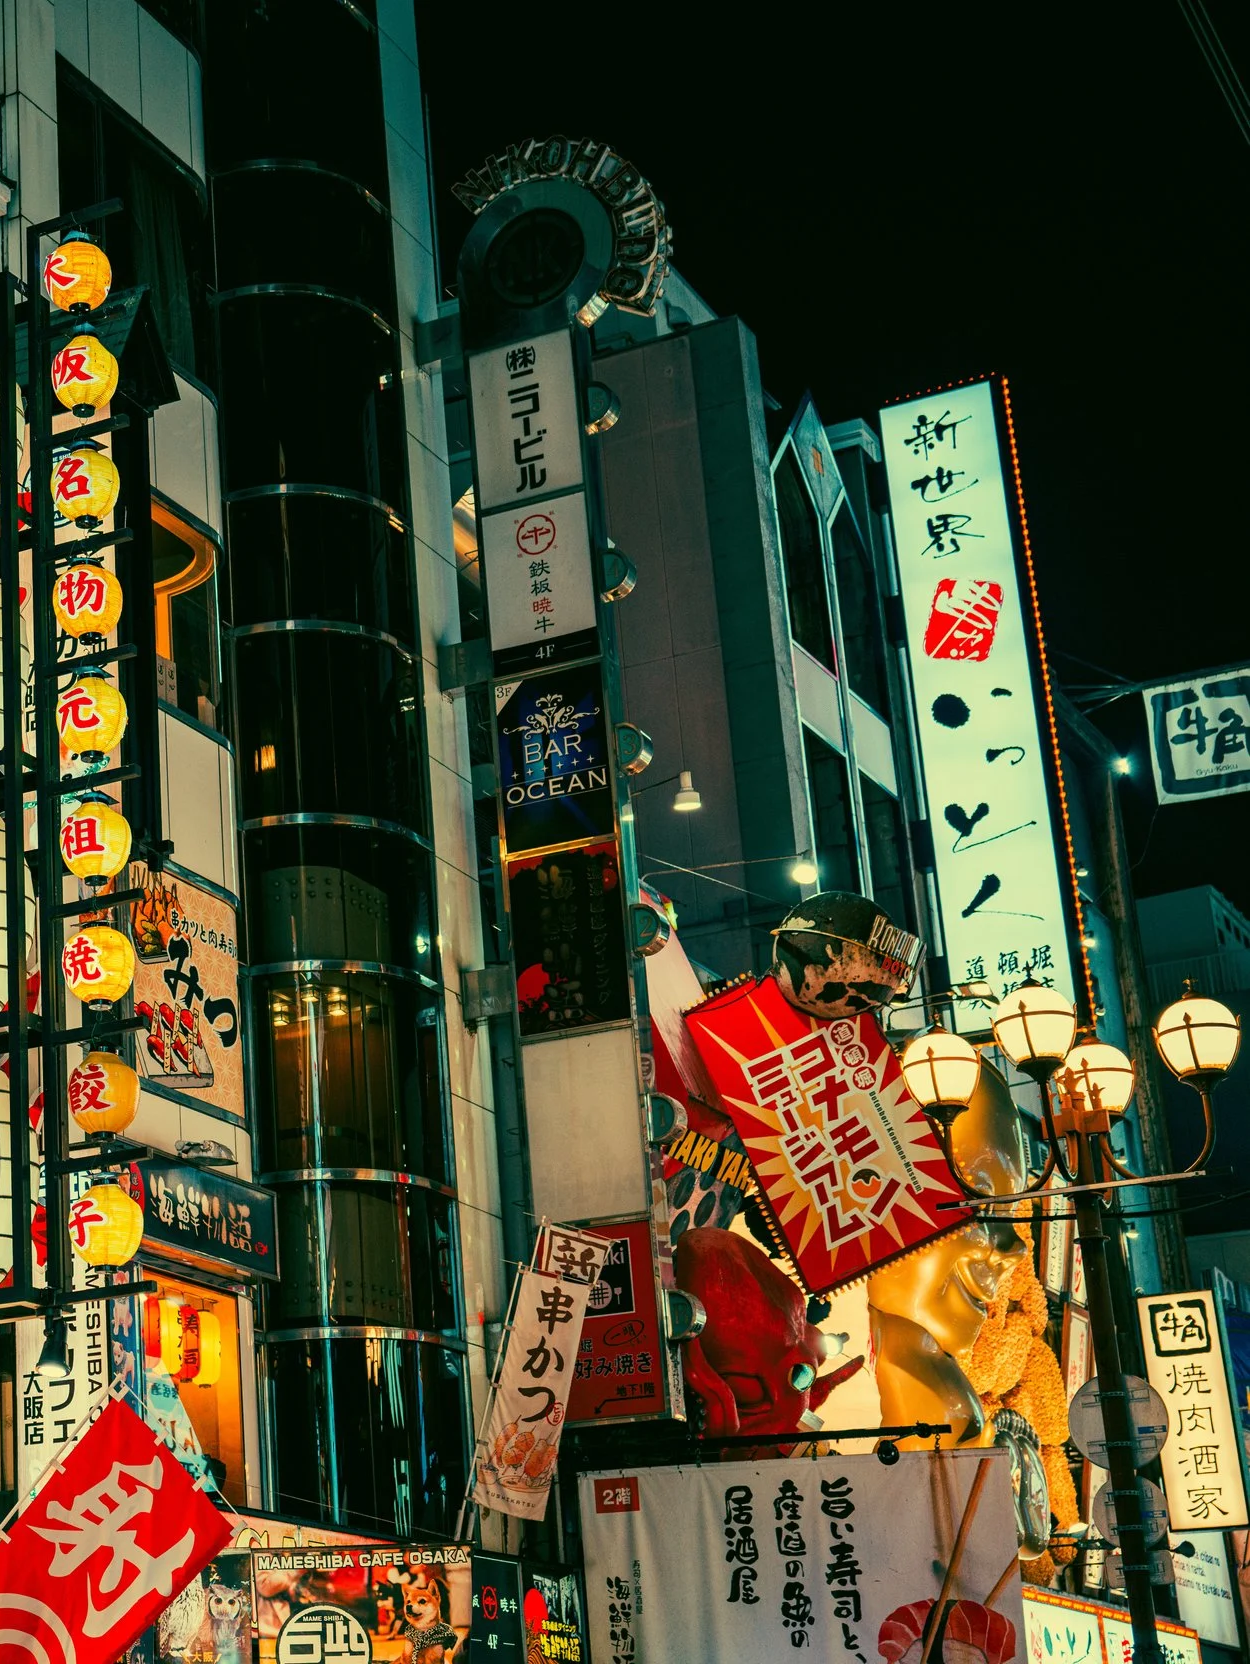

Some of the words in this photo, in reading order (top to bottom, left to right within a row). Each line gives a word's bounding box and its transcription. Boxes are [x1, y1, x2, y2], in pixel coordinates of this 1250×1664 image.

[904, 410, 985, 559] 新世界
[528, 559, 555, 634] 鉄板暁牛
[535, 644, 555, 660] 4F
[496, 685, 512, 700] 3F
[524, 733, 582, 765] BAR
[506, 767, 607, 806] OCEAN
[163, 934, 238, 1048] みつ
[830, 1022, 874, 1089] 道頓堀
[747, 1053, 866, 1245] ミュージアム
[790, 1033, 902, 1220] コナモン
[85, 1263, 103, 1396] AMESHIBA
[517, 1285, 575, 1423] 串かつ
[1160, 1310, 1205, 1343] 牛角
[574, 1352, 653, 1380] 好み焼き
[22, 1370, 44, 1446] 大阪店
[1165, 1362, 1229, 1520] 焼肉酒家
[486, 1490, 537, 1509] KUSHIKATSU
[602, 1487, 632, 1506] 2階
[26, 1455, 196, 1638] 射
[258, 1554, 354, 1571] MAMESHIBA
[358, 1552, 404, 1568] CAFE
[409, 1550, 468, 1566] OSAKA
[724, 1485, 761, 1605] 居酒屋
[773, 1479, 815, 1648] 産直の魚の
[302, 1615, 323, 1623] MAME
[323, 1614, 345, 1622] SHIBA
[487, 1634, 499, 1650] 4F
